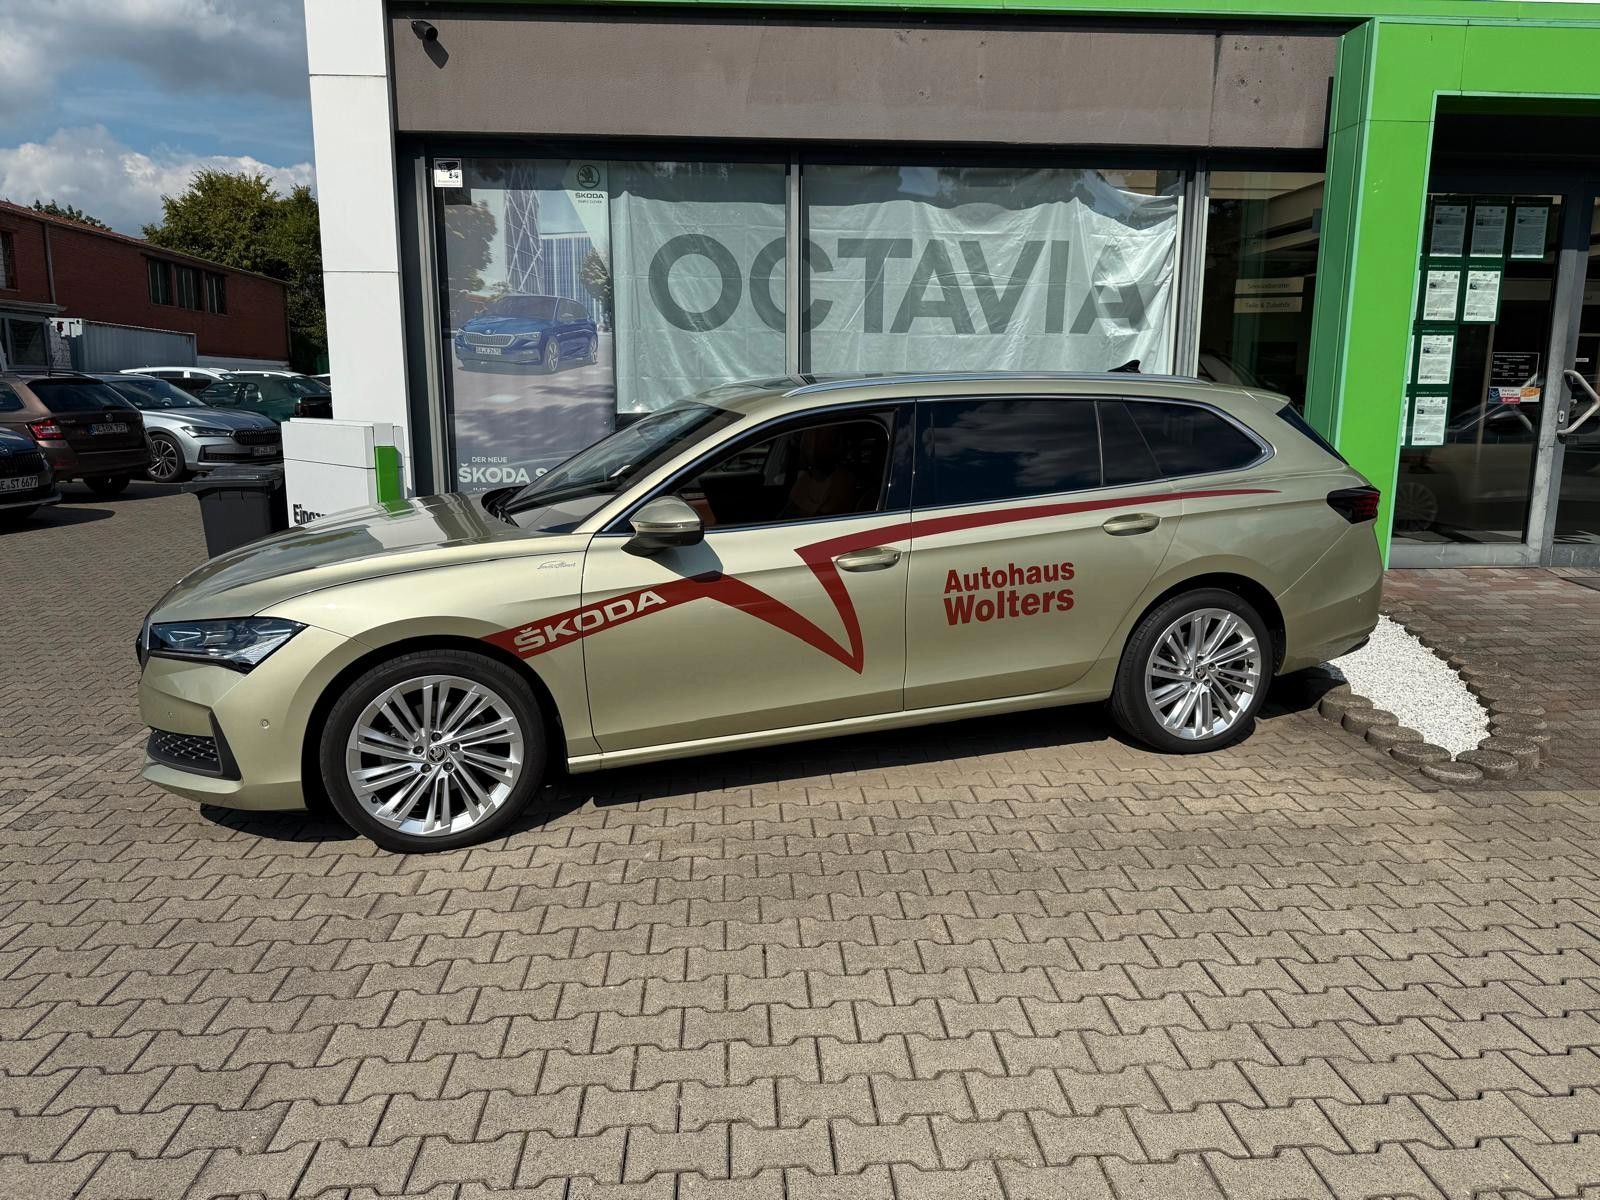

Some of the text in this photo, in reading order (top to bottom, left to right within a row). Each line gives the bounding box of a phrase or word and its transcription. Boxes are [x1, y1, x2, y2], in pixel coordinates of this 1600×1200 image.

[648, 233, 1152, 335] OCTAVIA
[458, 463, 549, 484] ŠKODA S
[943, 561, 1075, 595] Autohaus
[513, 590, 668, 653] ŠKODA
[943, 588, 1075, 626] Wolters
